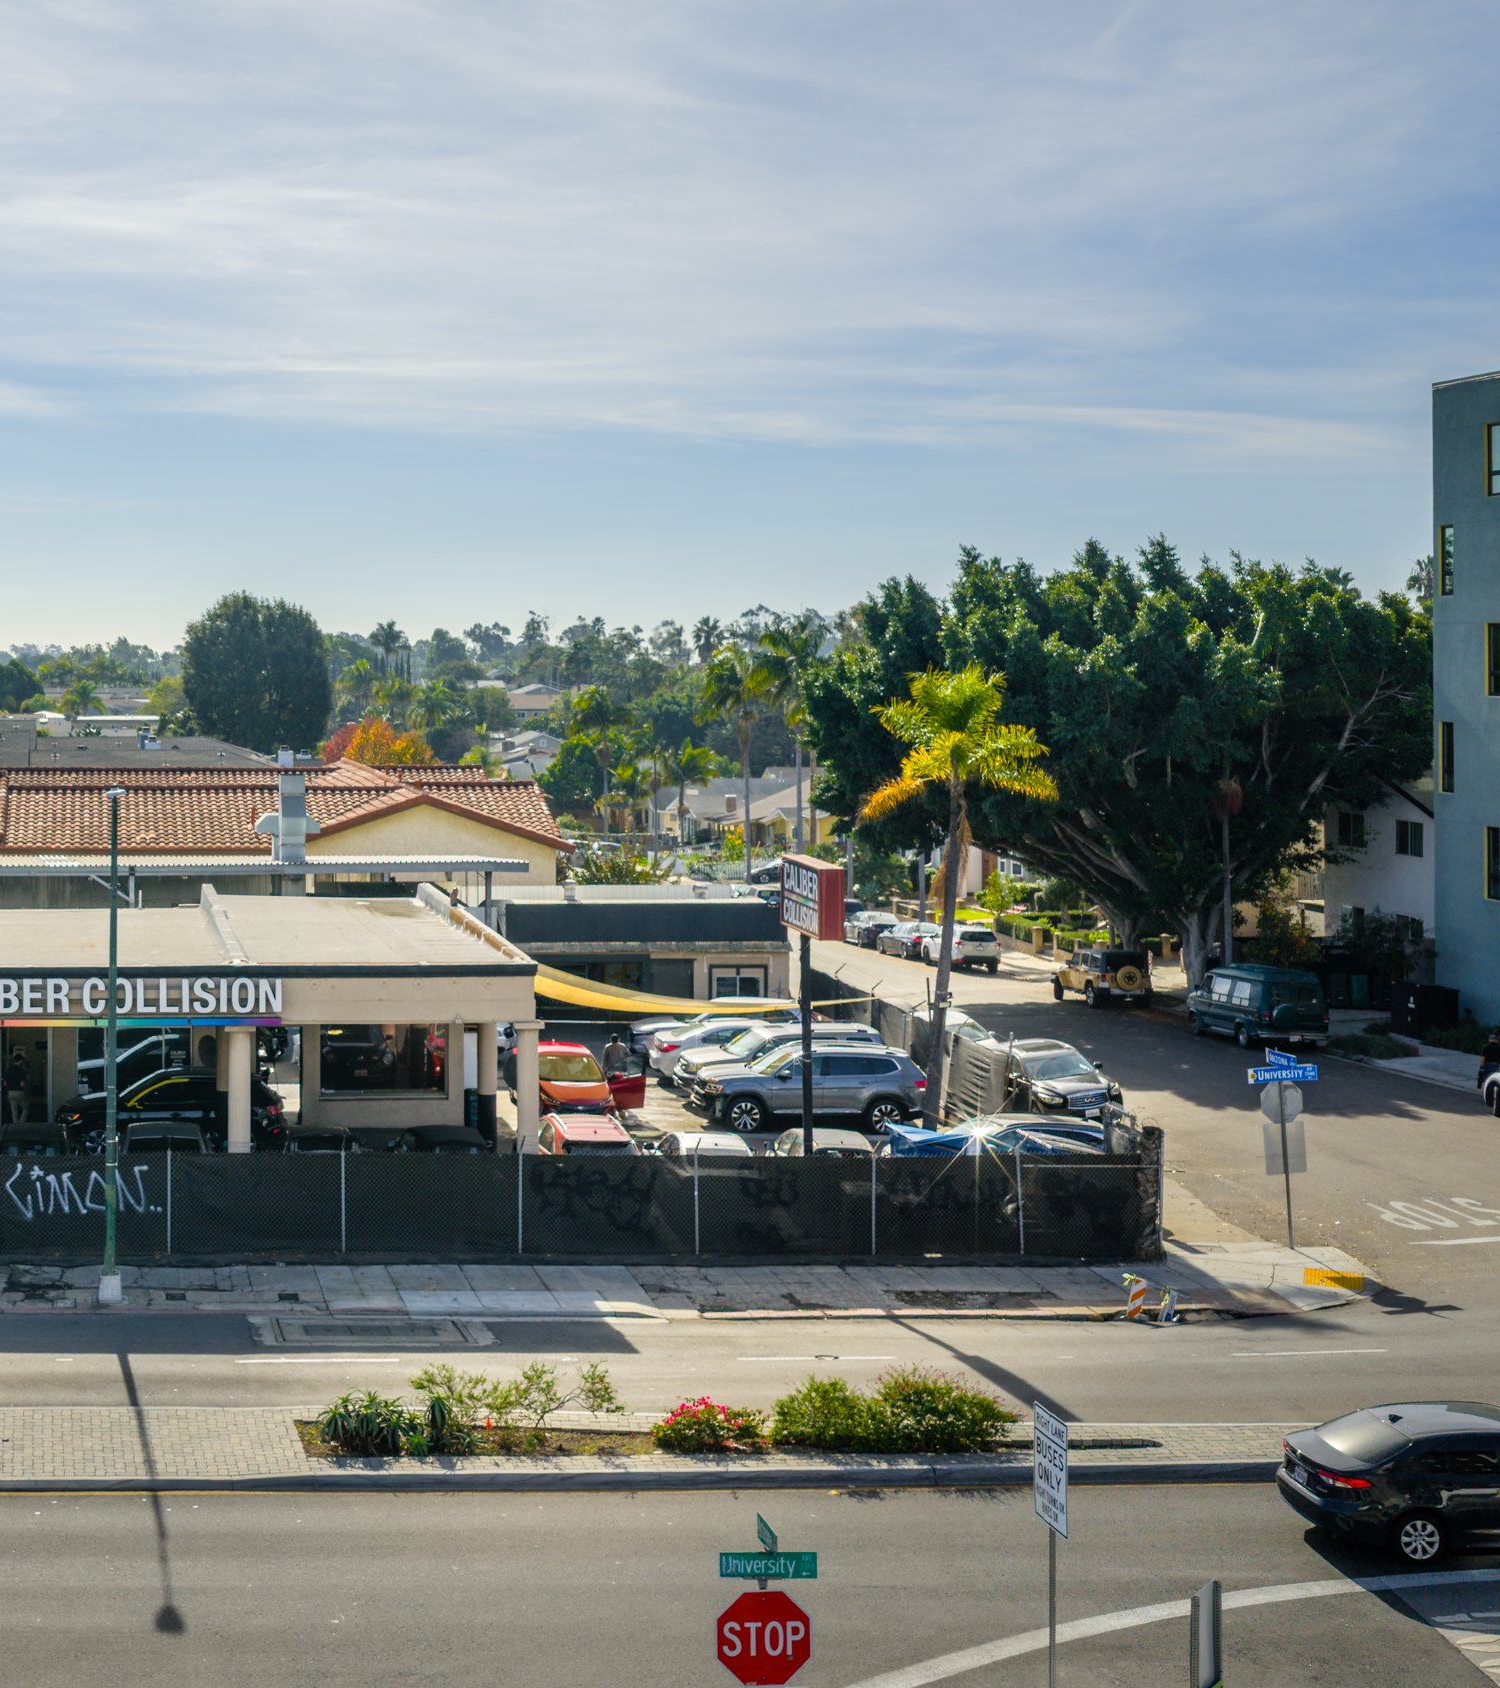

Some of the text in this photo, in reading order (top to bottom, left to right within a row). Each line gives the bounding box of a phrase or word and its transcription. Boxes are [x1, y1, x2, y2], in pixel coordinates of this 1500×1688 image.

[784, 863, 818, 901] CALIBER
[784, 899, 818, 934] COLLISION
[82, 977, 282, 1014] COLLISION
[1257, 1069, 1304, 1080] UNIVERSITY
[1051, 1423, 1066, 1444] LANE
[1036, 1436, 1064, 1473] BUSES
[1038, 1462, 1062, 1494] ONLY
[722, 1555, 796, 1578] University
[722, 1620, 805, 1657] STOP
